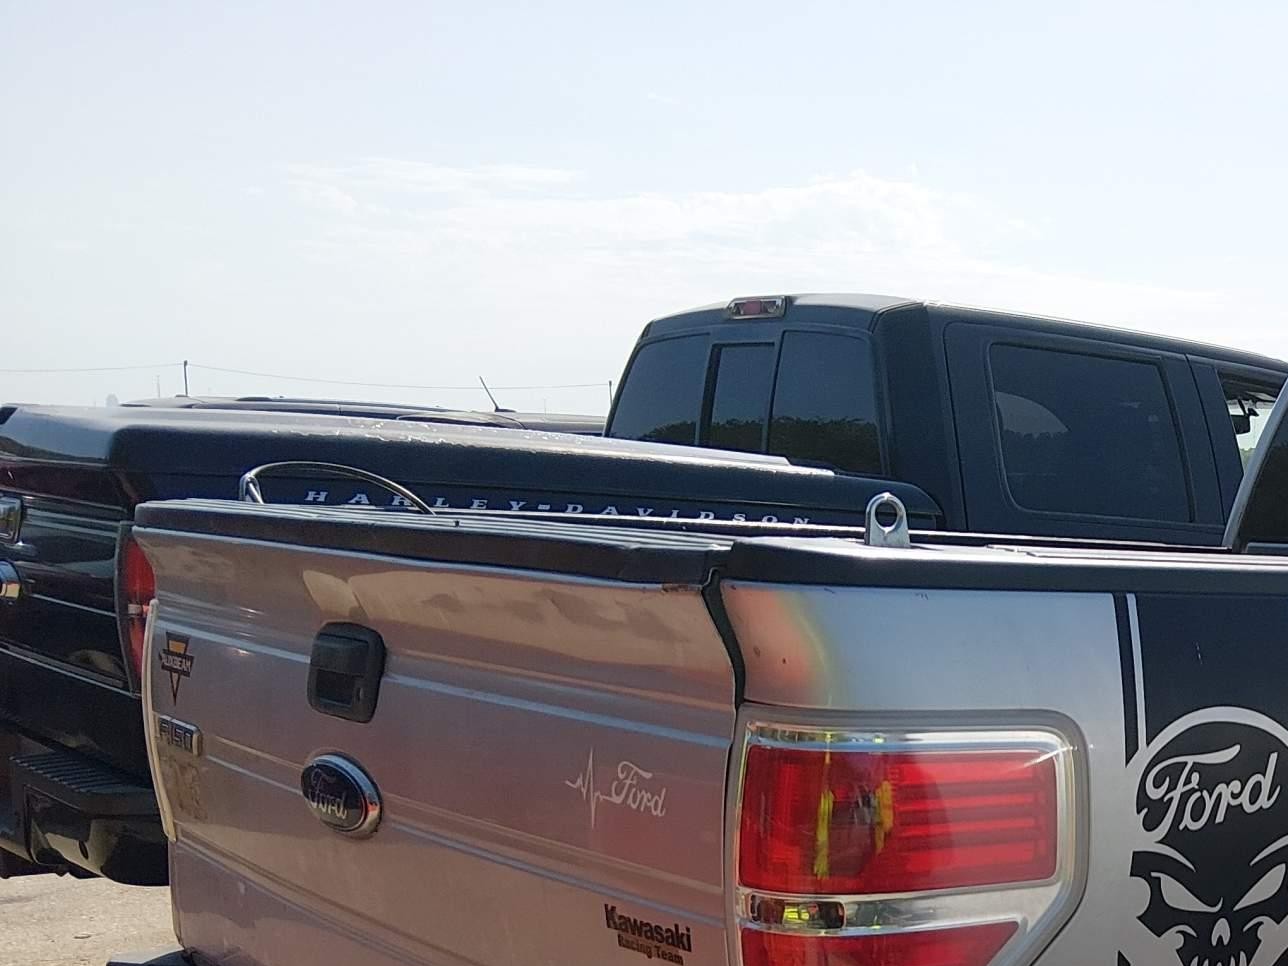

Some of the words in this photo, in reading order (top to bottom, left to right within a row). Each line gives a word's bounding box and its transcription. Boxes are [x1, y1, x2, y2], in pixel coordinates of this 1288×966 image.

[309, 766, 348, 820] Ford
[612, 761, 667, 817] Ford
[1139, 744, 1280, 840] Ford
[604, 903, 692, 952] Kawasaki
[617, 934, 653, 959] Racing
[654, 945, 684, 966] Team
